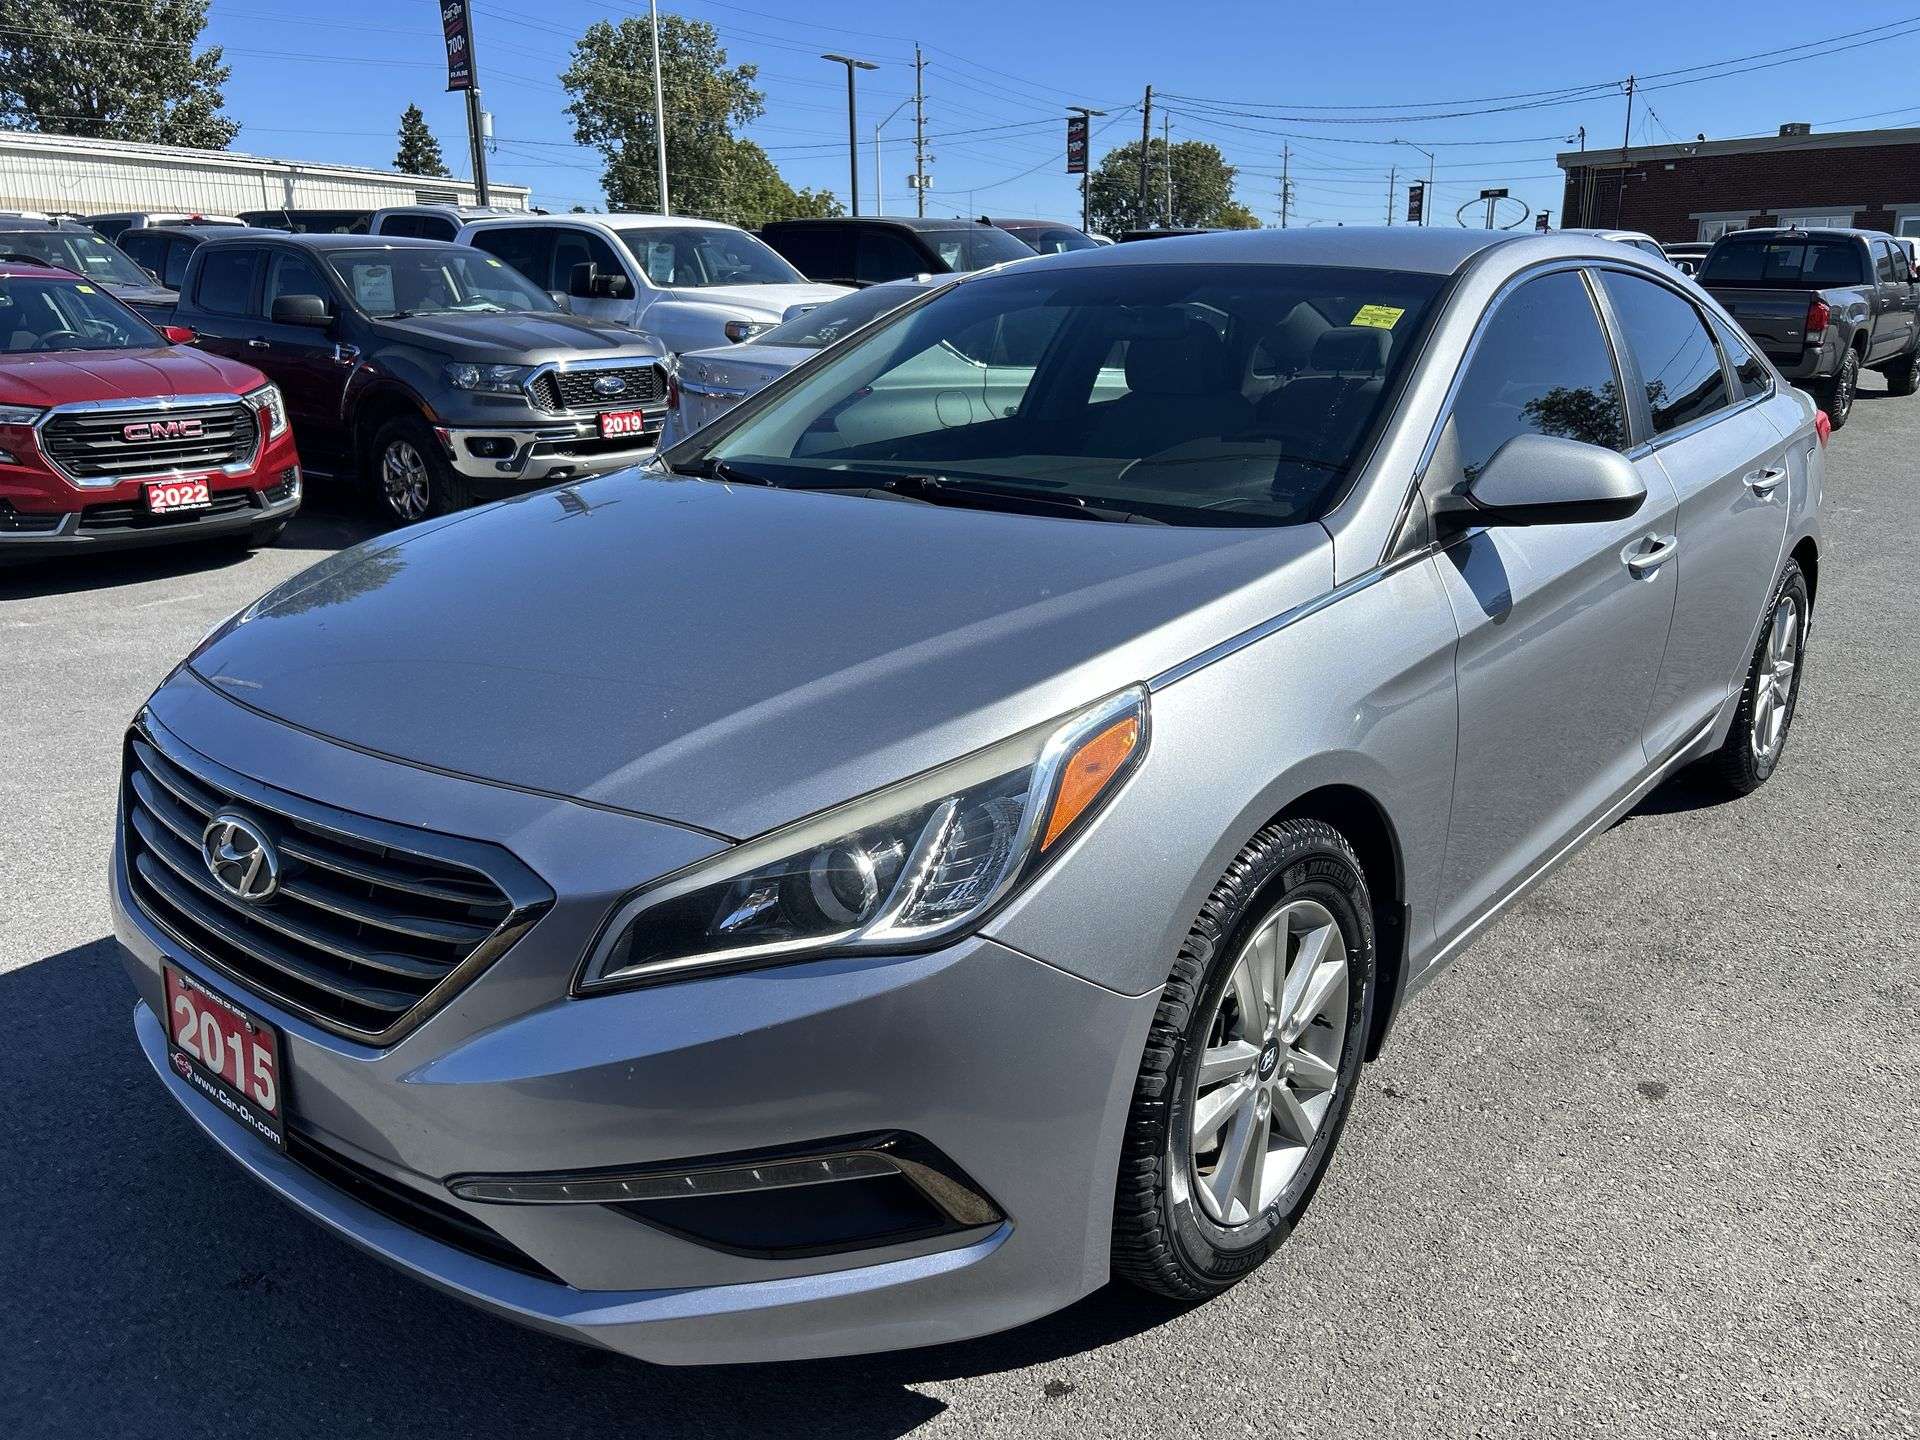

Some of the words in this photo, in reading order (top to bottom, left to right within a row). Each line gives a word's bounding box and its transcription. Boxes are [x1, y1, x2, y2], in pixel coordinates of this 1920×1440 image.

[447, 34, 465, 55] 700+
[450, 70, 469, 78] RAM
[124, 420, 203, 441] GMC
[604, 415, 641, 433] 2019
[151, 484, 209, 508] 2022
[175, 994, 276, 1112] 2015
[193, 1071, 281, 1146] www.Car-On.com
